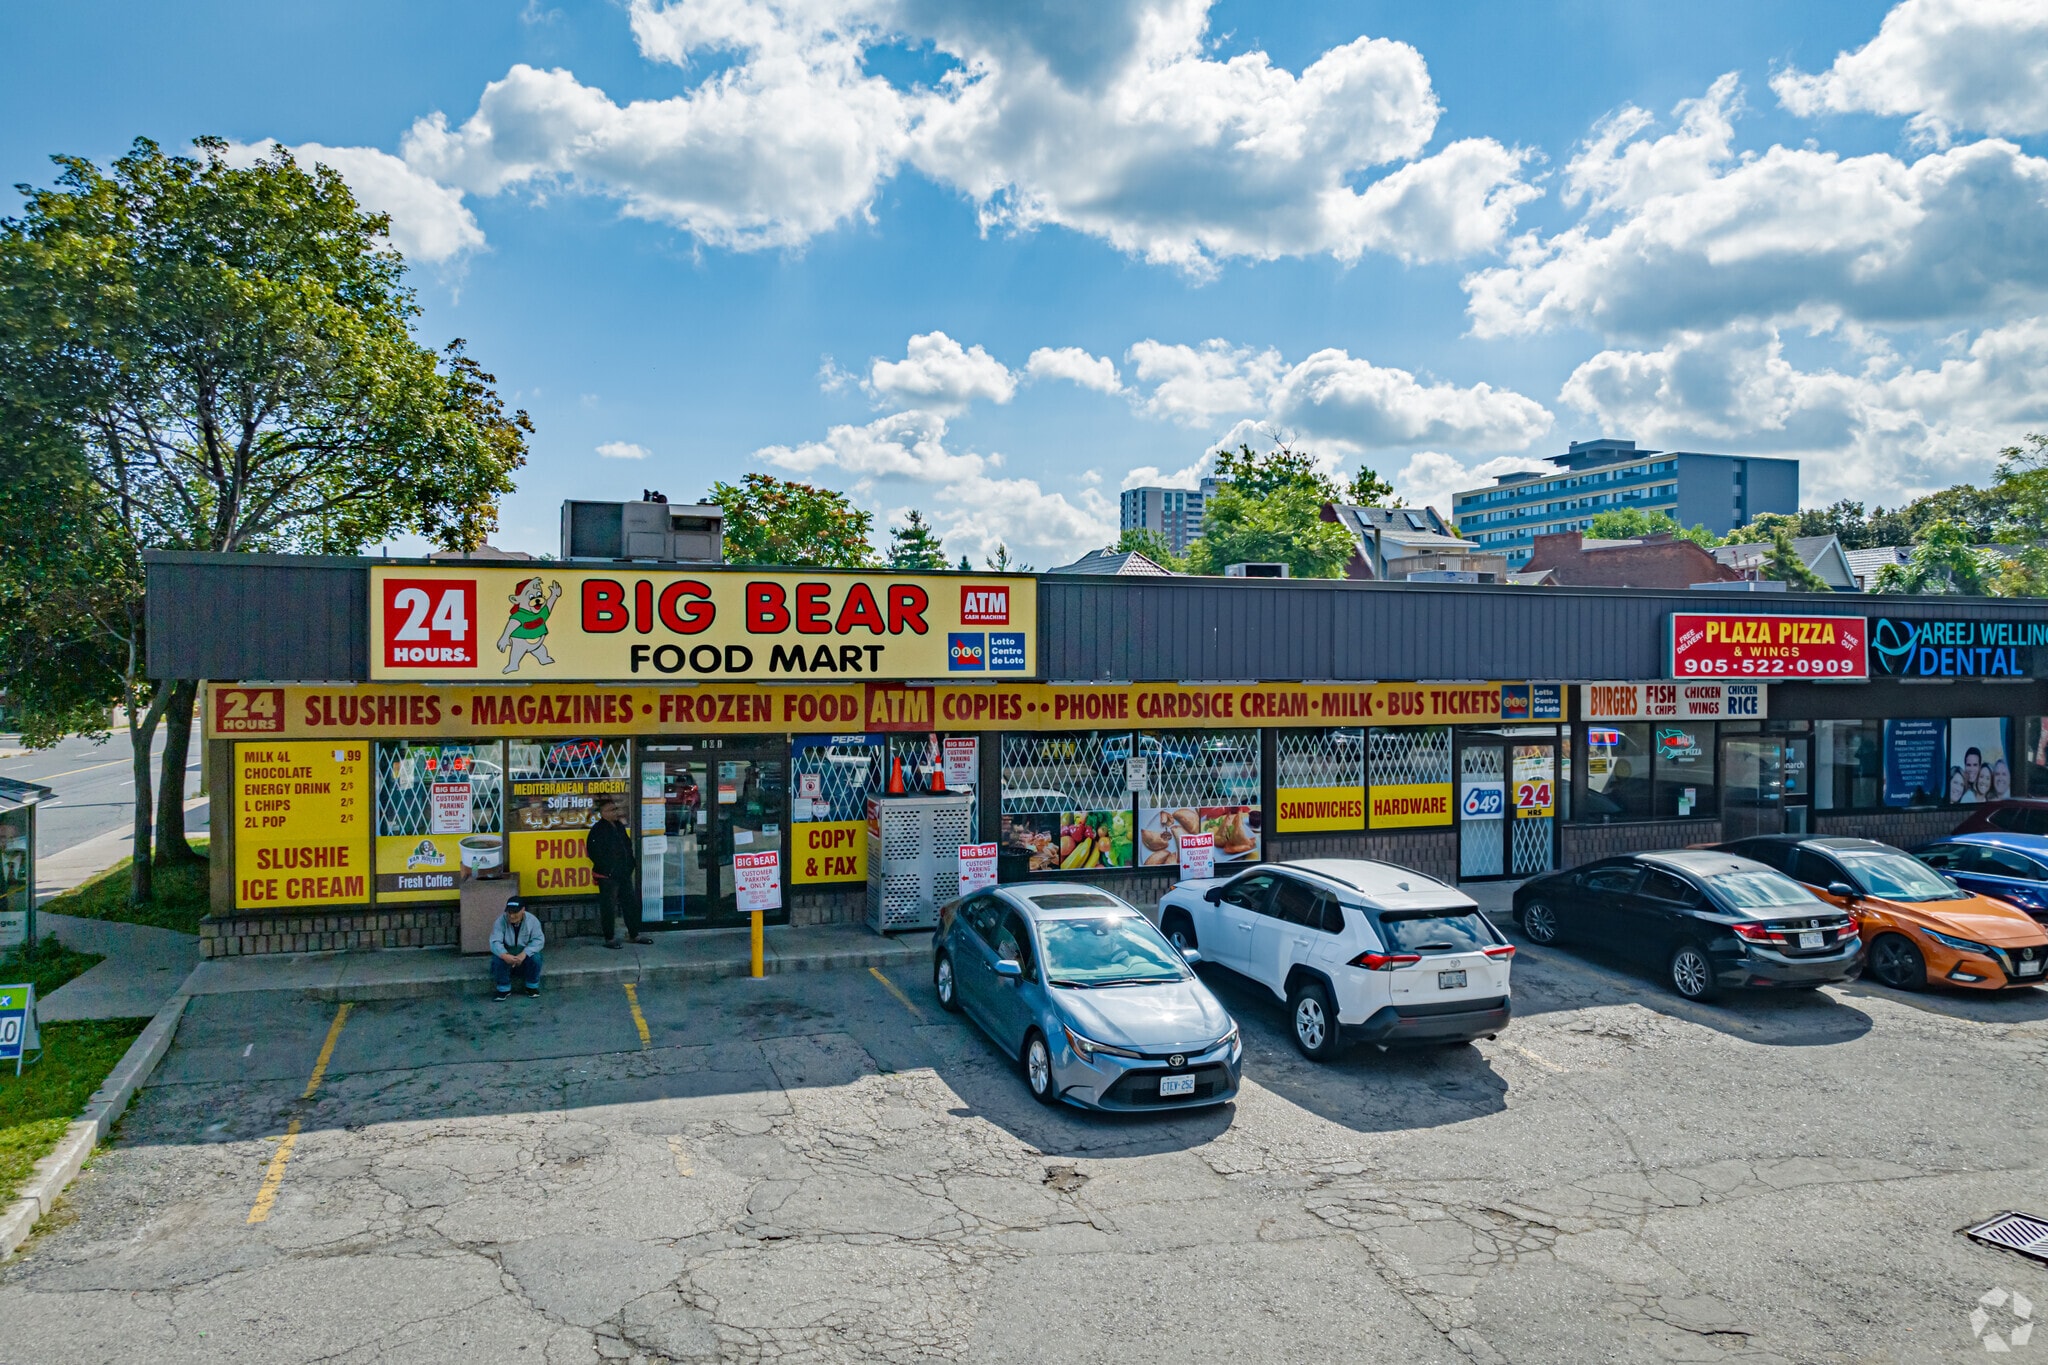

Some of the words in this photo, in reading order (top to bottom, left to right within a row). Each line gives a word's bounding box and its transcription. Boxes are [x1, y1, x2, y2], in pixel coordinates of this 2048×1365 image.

[579, 579, 715, 635] BIG
[745, 582, 928, 637] BEAR
[963, 592, 1007, 613] ATM
[393, 589, 468, 641] 24
[1679, 628, 1695, 644] FREE
[1706, 621, 1772, 644] PLAZA
[1778, 622, 1836, 644] PIZZA
[1842, 631, 1859, 647] TAKE
[1920, 623, 1974, 645] AREEJ
[991, 638, 1015, 646] Lotto
[1676, 630, 1704, 655] DELIVERY
[1840, 639, 1854, 651] OUT
[393, 648, 470, 662] HOURS.
[991, 647, 1022, 655] Centre
[1734, 646, 1742, 657] &
[1749, 646, 1800, 657] WINGS
[629, 644, 754, 675] FOOD
[768, 644, 885, 674] MART
[991, 656, 1003, 664] de
[1003, 656, 1024, 664] Loto
[1919, 647, 2024, 676] DENTAL
[1646, 685, 1677, 703] FISH
[1684, 686, 1721, 698] CHICKEN
[1727, 685, 1758, 695] CHICKEN
[224, 692, 276, 717] 24
[305, 694, 441, 726] SLUSHIES
[471, 693, 634, 725] MAGAZINES
[659, 694, 772, 723] FROZEN
[783, 693, 859, 722] FOOD
[870, 690, 929, 723] ATM
[942, 693, 1022, 720] COPIES
[1055, 692, 1129, 720] PHONE
[1240, 692, 1309, 717] CREAM
[1320, 692, 1373, 717] MILK
[1387, 690, 1425, 716] BUS
[1430, 690, 1500, 715] TICKETS
[1590, 686, 1638, 716] BURGERS
[1688, 702, 1720, 714] WINGS
[1727, 696, 1758, 714] RICE
[1646, 705, 1652, 715] &
[1654, 704, 1677, 715] CHIPS
[223, 718, 277, 731] HOURS
[831, 735, 866, 744] PEPSI
[244, 752, 274, 763] MILK
[278, 752, 291, 762] 4L
[1686, 748, 1702, 756] PIZZA
[244, 767, 313, 779] CHOCOLATE
[244, 783, 291, 796] ENERGY
[295, 782, 331, 795] DRINK
[514, 782, 584, 796] MEDITERRANEAN
[588, 781, 626, 794] GROCERY
[547, 797, 569, 809] Sold
[571, 796, 594, 808] Here
[1518, 784, 1552, 808] 24
[244, 800, 251, 812] L
[255, 799, 291, 811] CHIPS
[1280, 800, 1362, 820] SANDWICHES
[1373, 796, 1447, 817] HARDWARE
[244, 816, 258, 828] 2L
[262, 816, 286, 828] POP
[808, 828, 857, 850] COPY
[1183, 838, 1196, 847] BIG
[536, 838, 590, 860] PHON
[961, 848, 976, 857] BIG
[977, 847, 996, 857] BEAR
[257, 846, 349, 870] SLUSHIE
[736, 857, 752, 867] BIG
[753, 855, 777, 866] BEAR
[966, 859, 993, 867] CUSTOMER
[741, 868, 774, 877] CUSTOMER
[805, 857, 819, 877] &
[824, 856, 858, 877] FAX
[398, 875, 424, 889] Fresh
[425, 874, 454, 888] Coffee
[745, 875, 771, 883] PARKING
[242, 878, 278, 901] ICE
[286, 875, 364, 899] CREAM
